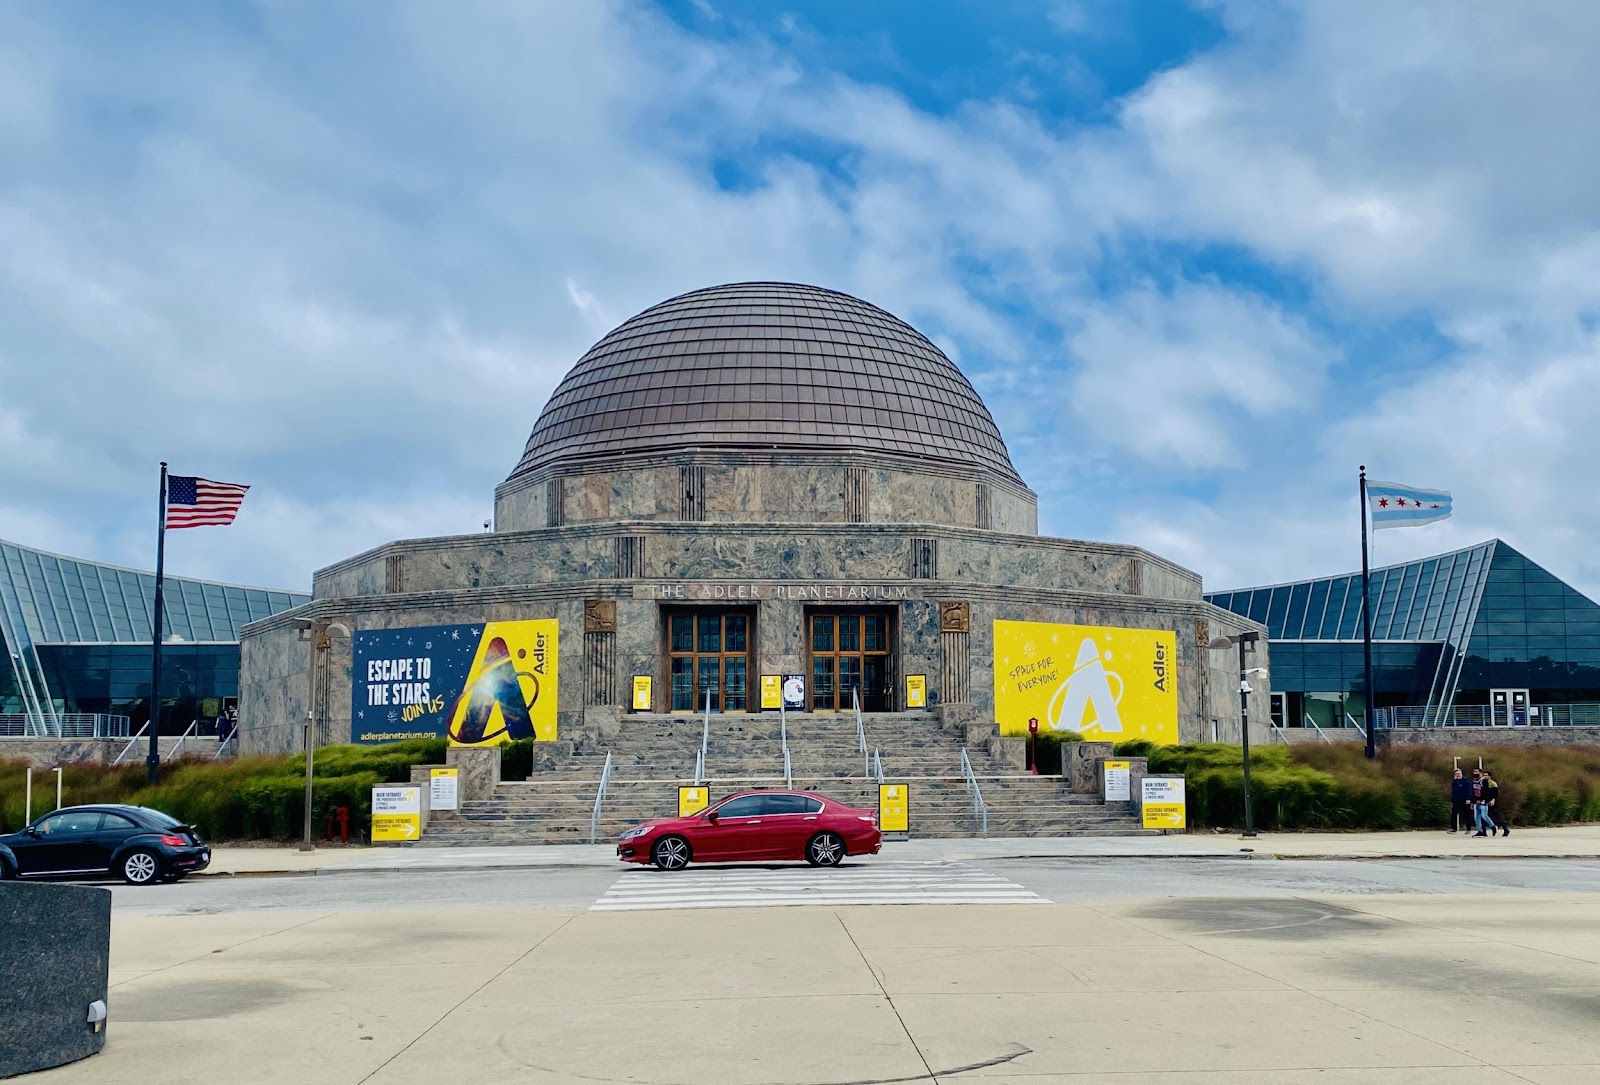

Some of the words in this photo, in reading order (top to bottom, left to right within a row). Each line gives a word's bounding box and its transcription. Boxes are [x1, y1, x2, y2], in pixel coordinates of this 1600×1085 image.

[649, 585, 684, 598] THE
[702, 585, 760, 598] ADLER
[777, 585, 907, 598] PLANETARIUM
[533, 631, 545, 675] Adler
[367, 658, 413, 682] ESCAPE
[416, 657, 431, 680] TO
[1009, 663, 1036, 680] SPACE
[1037, 656, 1055, 670] FOR
[1153, 641, 1165, 693] Adler
[1017, 668, 1059, 693] EVERYONE!
[367, 684, 389, 706] THE
[392, 682, 431, 705] STARS
[401, 703, 425, 722] JOIN
[427, 693, 445, 714] US
[360, 731, 437, 742] adlerplanetarium.org
